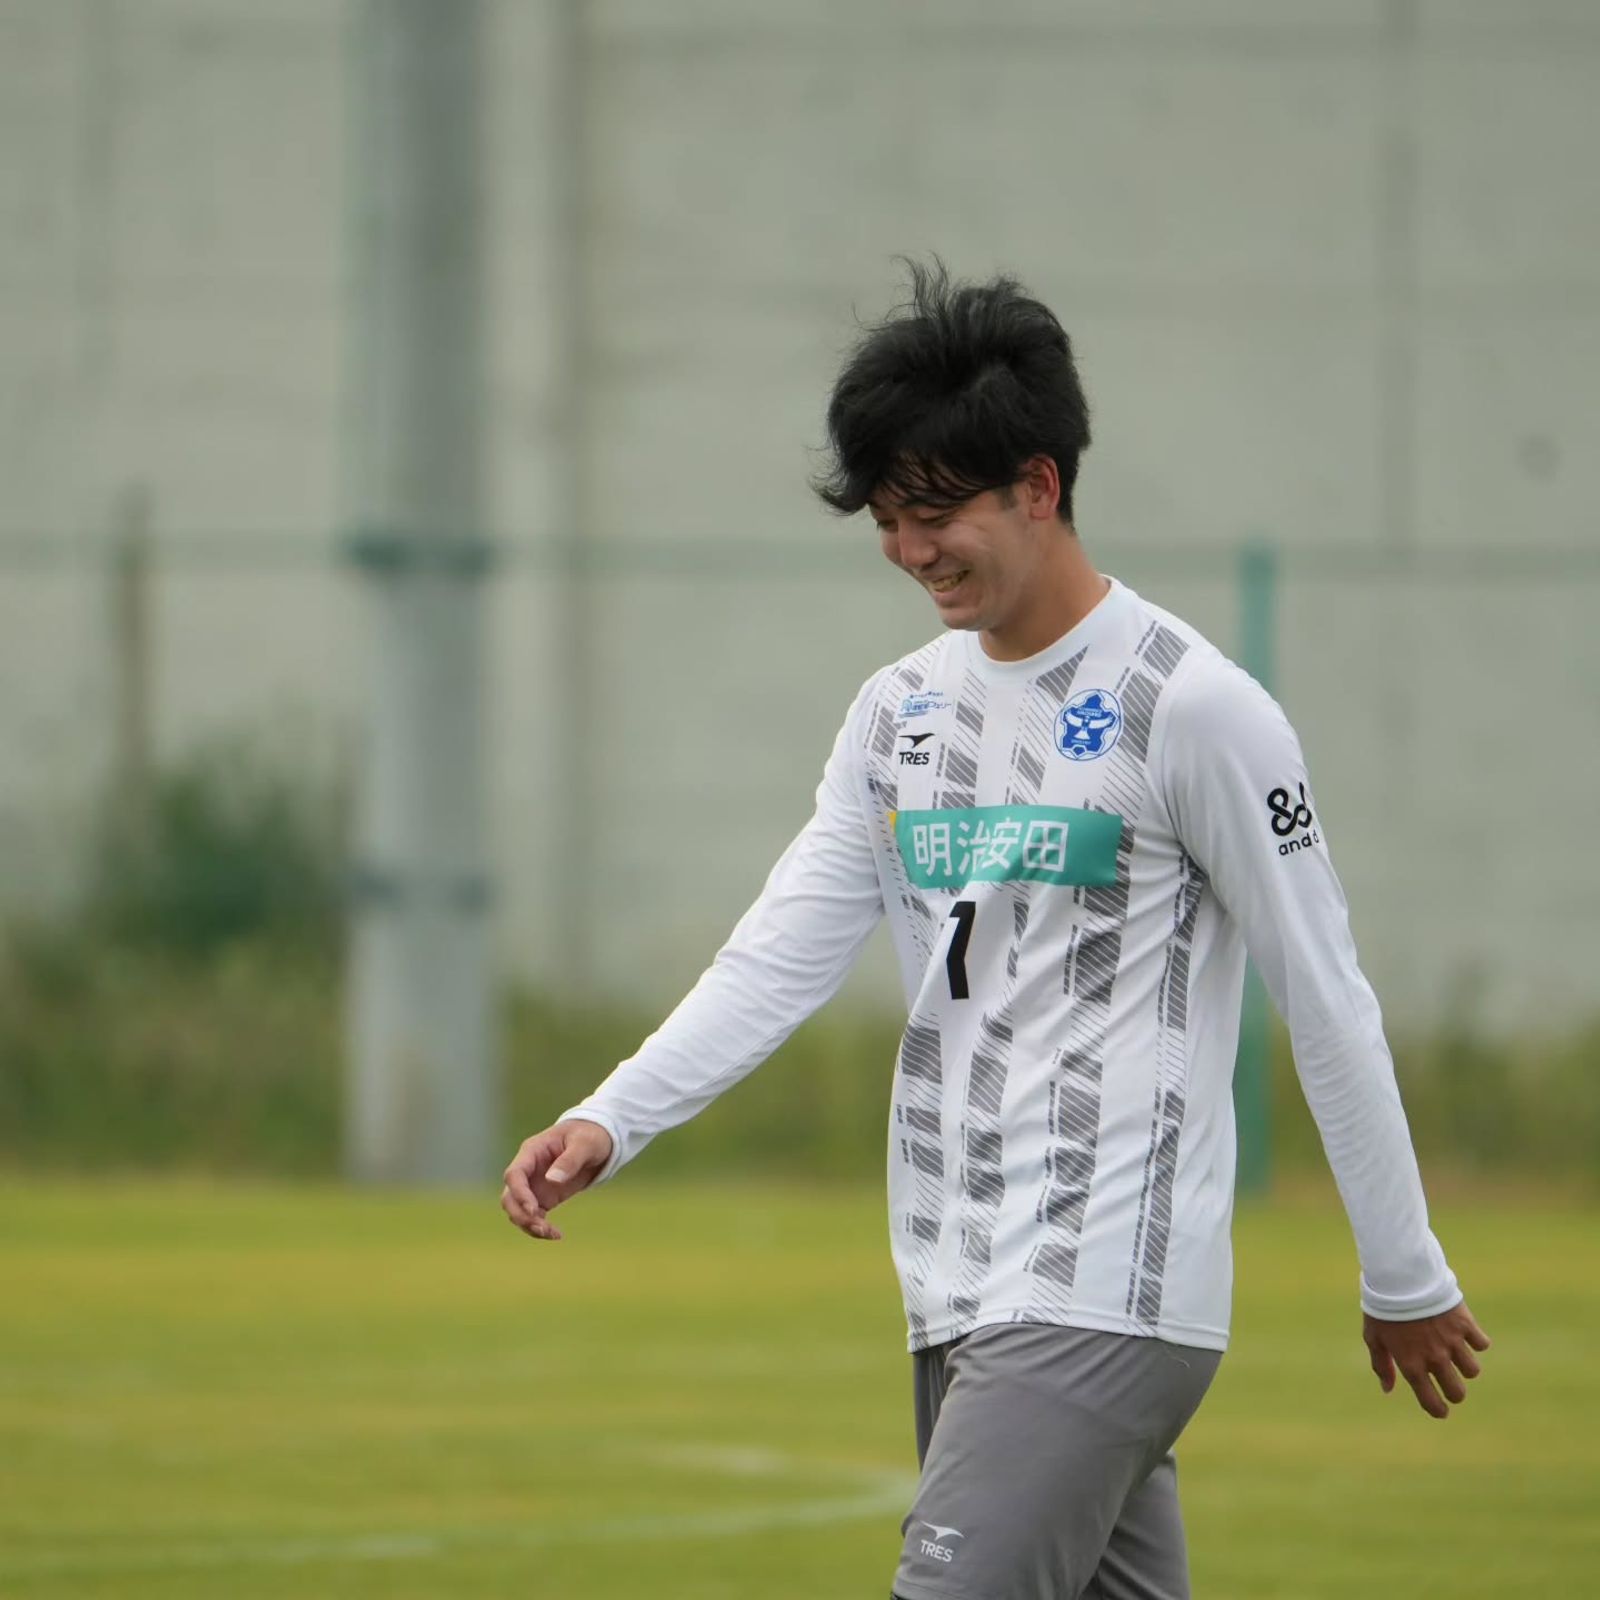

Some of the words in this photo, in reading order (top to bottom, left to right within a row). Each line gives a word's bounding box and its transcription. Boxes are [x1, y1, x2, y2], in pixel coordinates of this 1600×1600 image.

[899, 751, 930, 765] TRES
[946, 901, 976, 1000] 1
[920, 1539, 954, 1562] TRES
